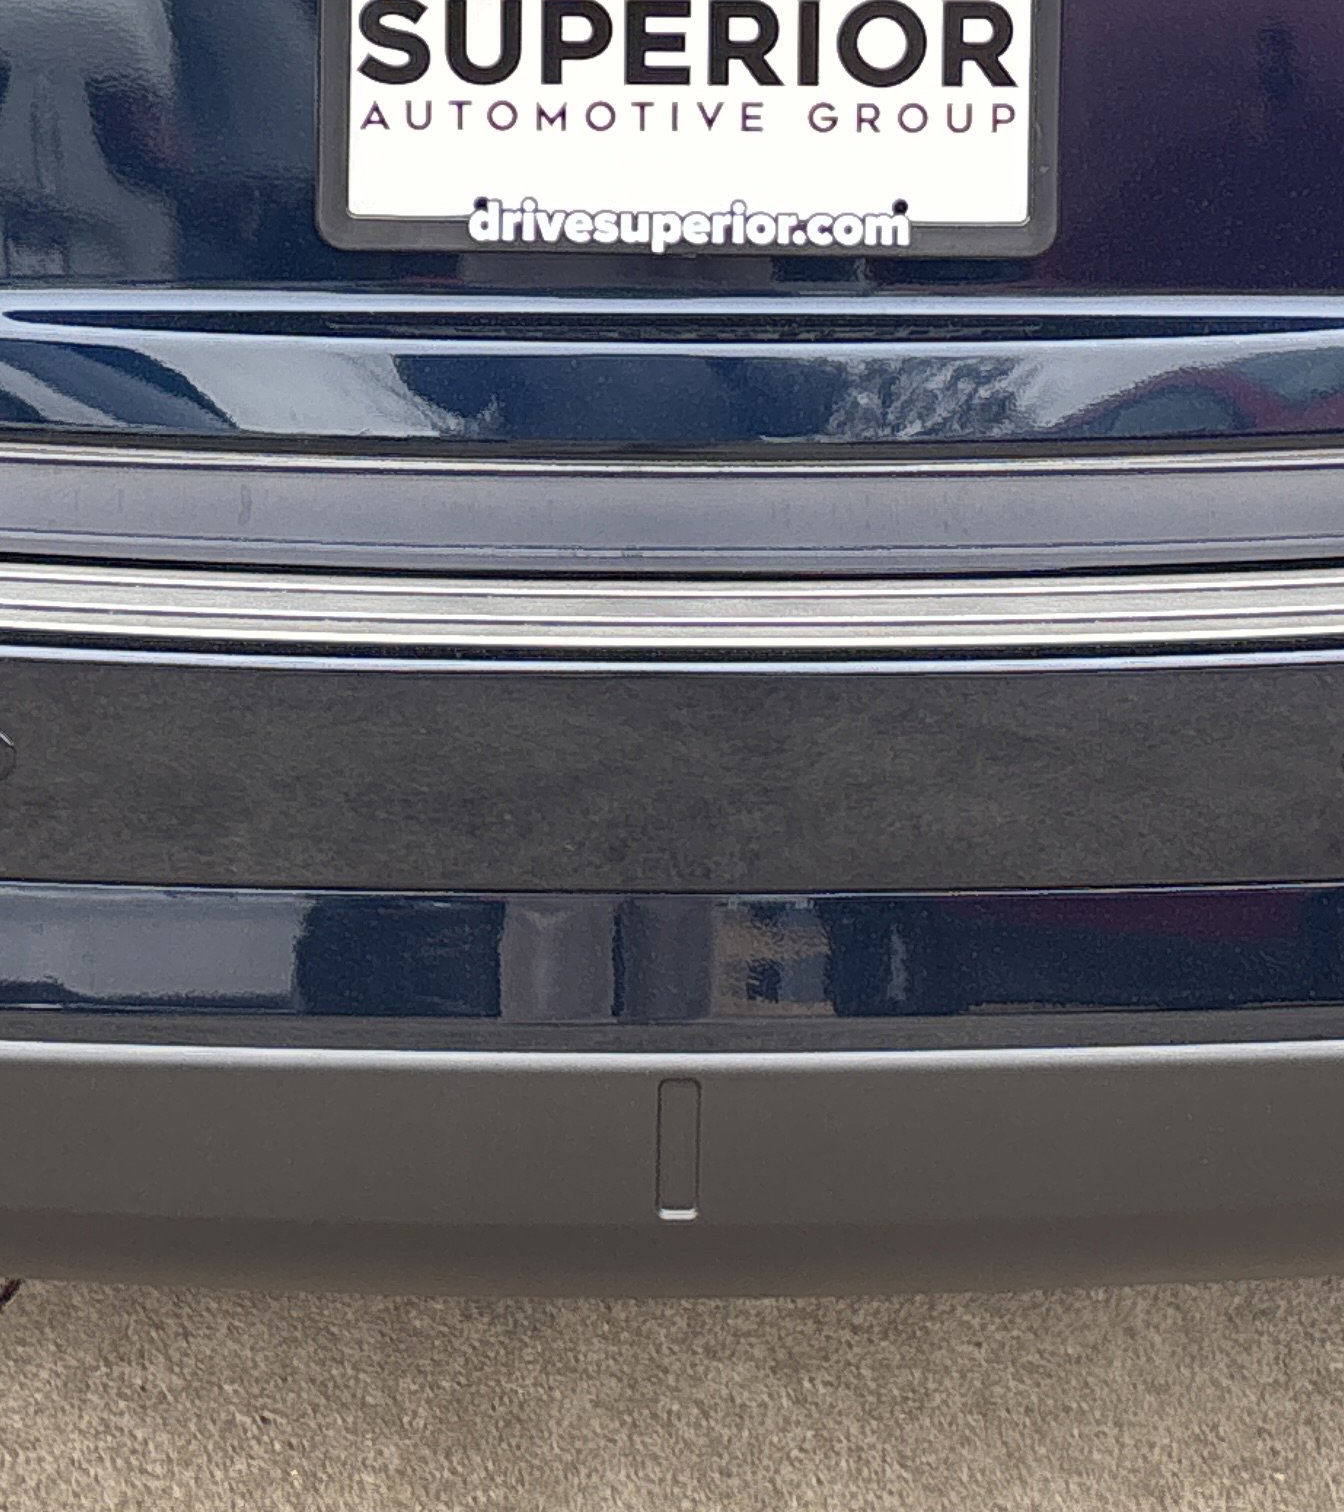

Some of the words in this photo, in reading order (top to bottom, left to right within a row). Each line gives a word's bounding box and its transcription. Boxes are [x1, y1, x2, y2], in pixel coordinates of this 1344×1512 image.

[360, 100, 764, 133] AUTOMOTIVE
[809, 102, 1017, 134] GROUP
[468, 196, 911, 252] drivesuperior.com
